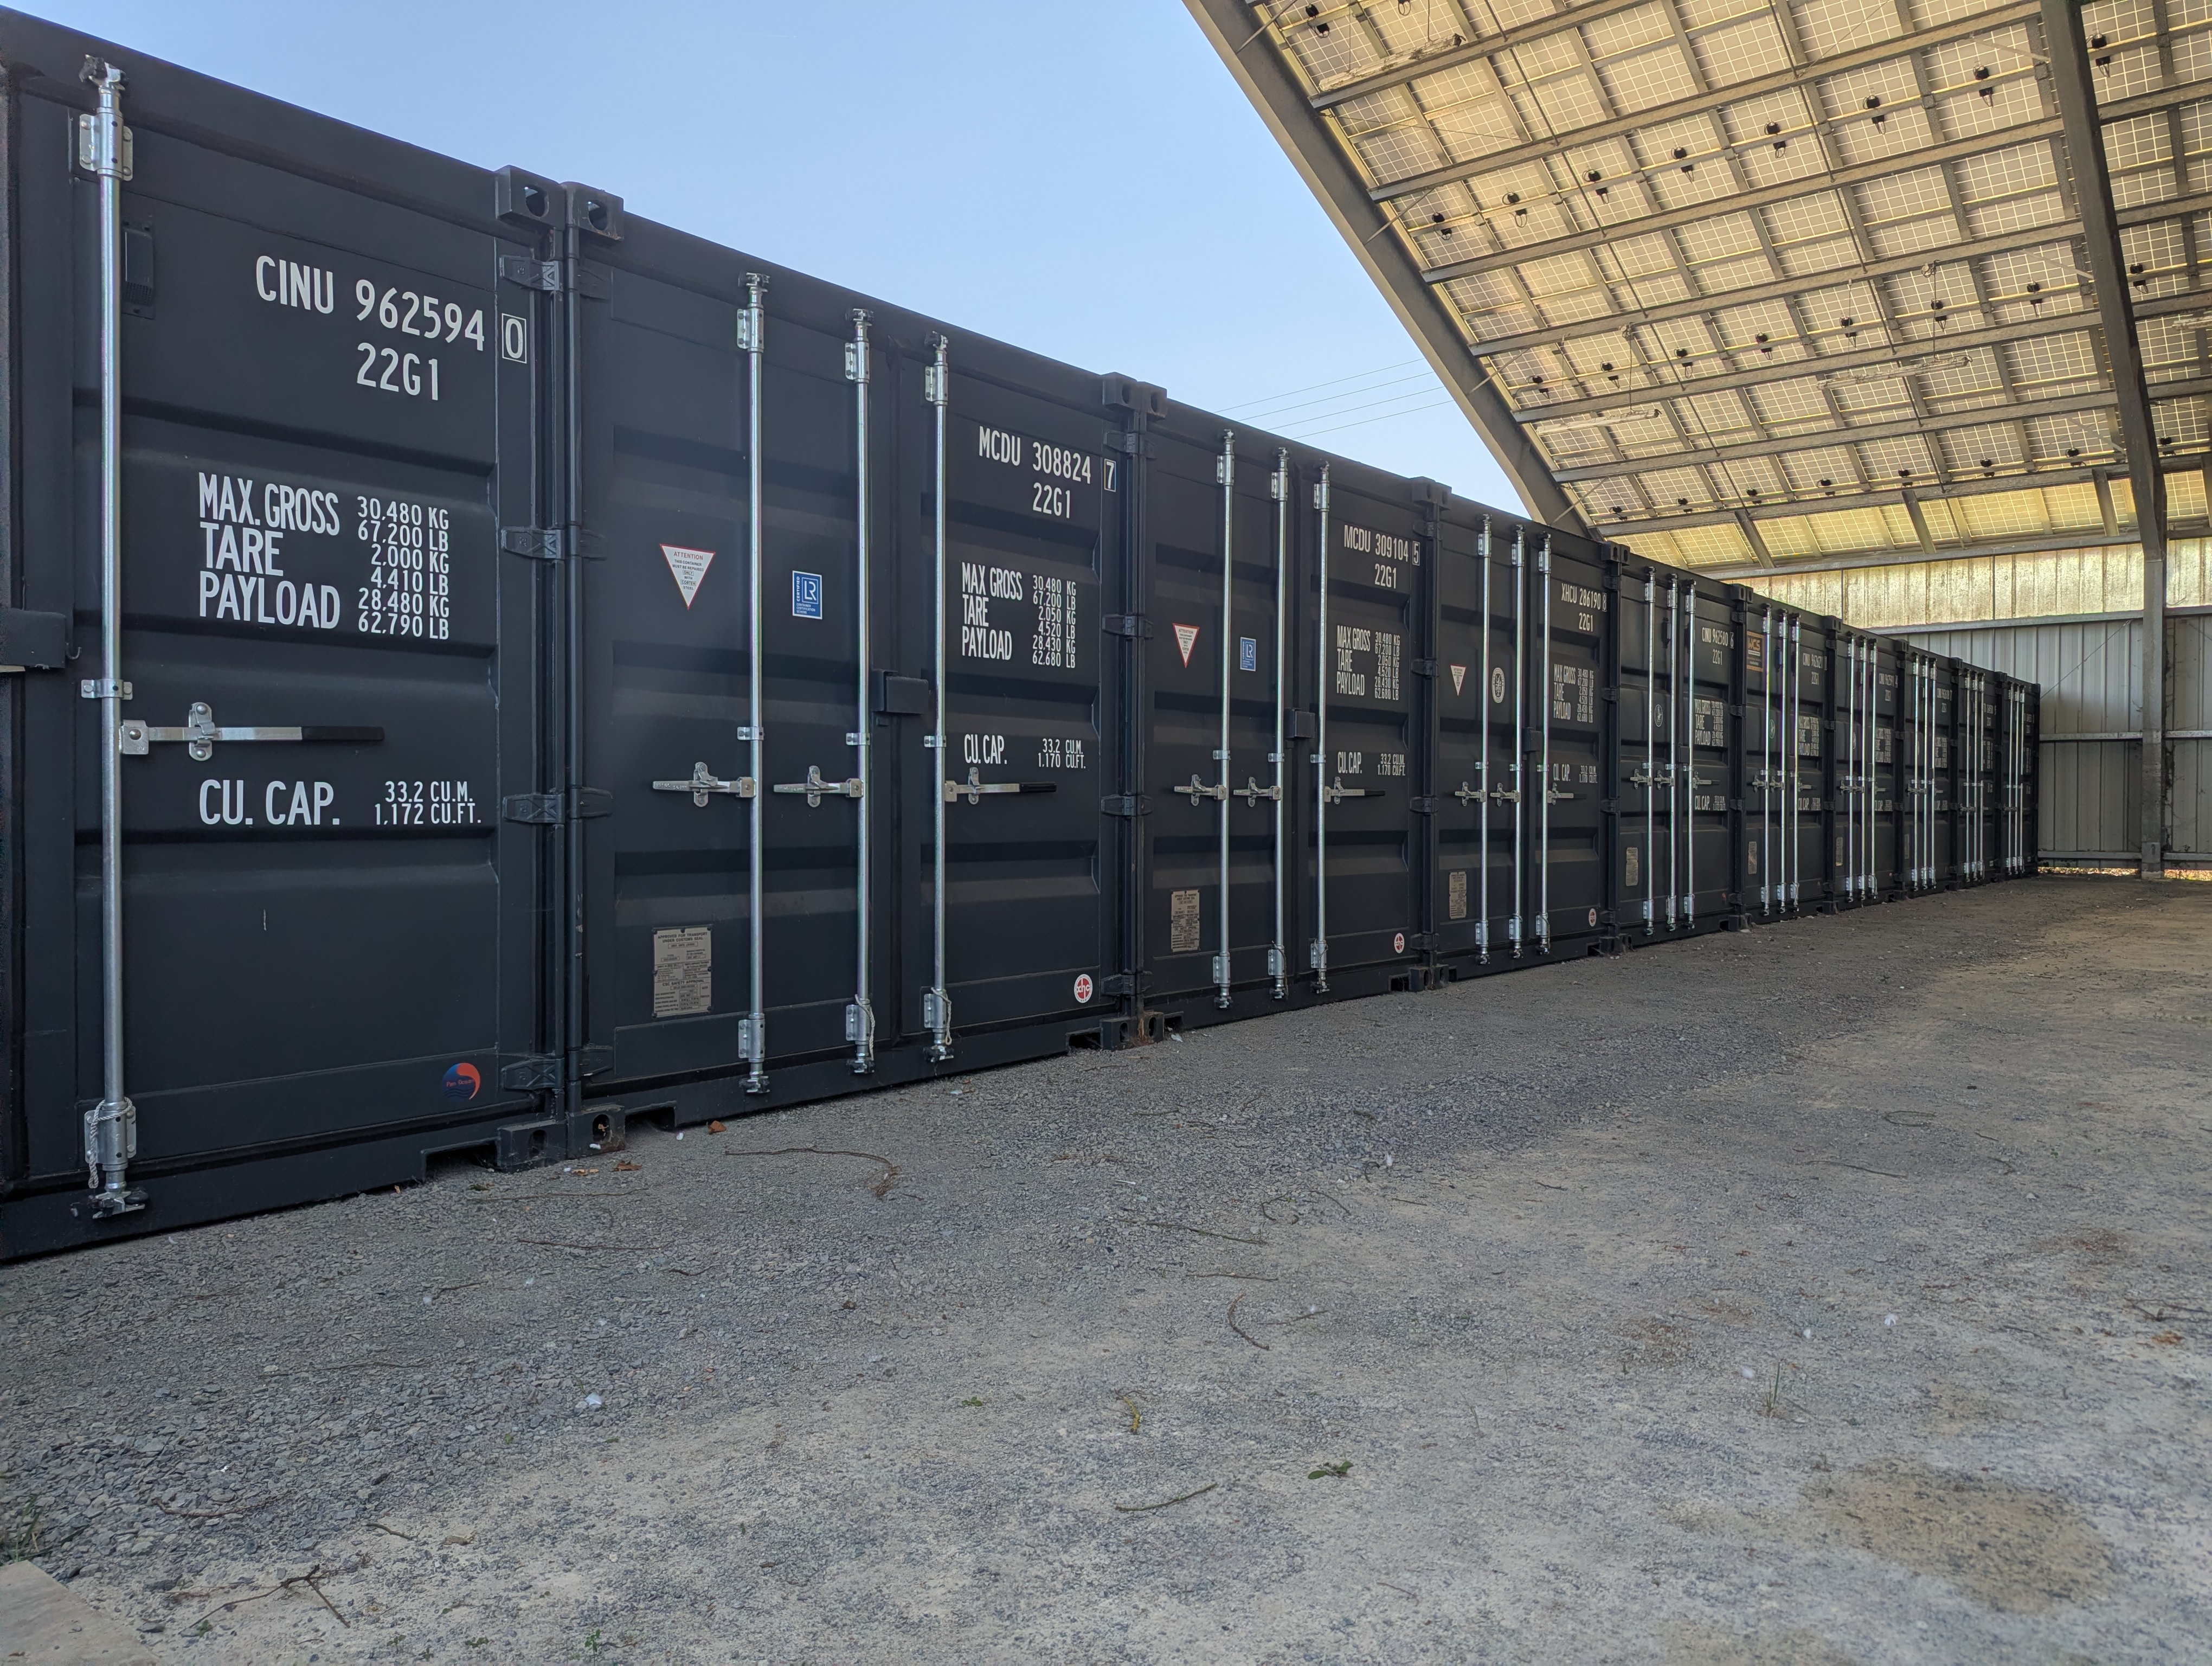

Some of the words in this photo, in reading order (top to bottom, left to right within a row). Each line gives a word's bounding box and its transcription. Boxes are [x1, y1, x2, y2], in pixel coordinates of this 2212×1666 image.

[255, 255, 335, 314] CINU
[356, 278, 485, 351] 962594
[356, 342, 440, 401] 22G1
[979, 426, 1021, 466] MCDU
[1032, 441, 1091, 484] 308824
[198, 472, 261, 526] MAX.
[265, 484, 340, 535] GROSS
[1032, 482, 1071, 519] 22G1
[357, 496, 422, 525] 30,480
[428, 507, 449, 530] KG
[358, 519, 423, 548] 67,200
[429, 529, 449, 552] LB
[1343, 524, 1371, 553] MCDU
[1375, 533, 1409, 562] 309104
[200, 521, 284, 576] TARE
[371, 543, 423, 570] 2,000
[429, 550, 449, 574] KG
[673, 551, 703, 560] ATTENTION
[370, 566, 423, 593] 4,410
[429, 573, 449, 596] LB
[961, 561, 986, 596] MAX
[990, 567, 1023, 601] GROSS
[1374, 563, 1397, 589] 22G1
[804, 580, 817, 601] LR
[1066, 580, 1076, 596] KG
[1561, 582, 1577, 604] XHCU
[1579, 588, 1601, 610] 286190
[198, 571, 340, 629] PAYLOAD
[358, 587, 423, 615] 28,480
[429, 595, 449, 618] KG
[963, 594, 989, 627] TARE
[1066, 595, 1076, 611] LB
[358, 610, 423, 637] 62,790
[429, 617, 449, 640] LB
[1066, 610, 1076, 625] KG
[1579, 612, 1593, 632] 22G1
[961, 625, 1012, 661] PAYLOAD
[1066, 624, 1076, 639] LB
[1337, 624, 1352, 649] MAX
[1352, 627, 1371, 652] GROSS
[1393, 634, 1400, 646] KG
[1702, 627, 1712, 643] CINU
[1066, 639, 1076, 654] KG
[1393, 645, 1400, 657] LB
[1712, 649, 1722, 666] 22G1
[1066, 653, 1076, 668] LB
[1337, 649, 1353, 672] TARE
[1393, 656, 1400, 668] KG
[1336, 671, 1365, 696] PAYLOAD
[1392, 667, 1399, 679] LB
[1392, 678, 1399, 689] KG
[1392, 689, 1399, 701] LB
[1553, 682, 1565, 701] TARE
[1695, 714, 1705, 730] TARE
[964, 733, 981, 764] CU.
[983, 734, 1007, 765] CAP.
[1042, 738, 1060, 753] 33.2
[1065, 739, 1083, 754] CU.M.
[1038, 752, 1061, 768] 1,170
[1065, 754, 1086, 768] CU.FT.
[1338, 751, 1348, 774] CU.
[1348, 752, 1362, 774] CAP.
[1380, 753, 1391, 765] 33.2
[199, 779, 253, 825] CU.
[265, 780, 340, 825] CAP.
[384, 780, 423, 803] 33.2
[430, 780, 473, 802] CU.M.
[375, 803, 424, 825] 1,172
[430, 803, 481, 824] CU.FT.
